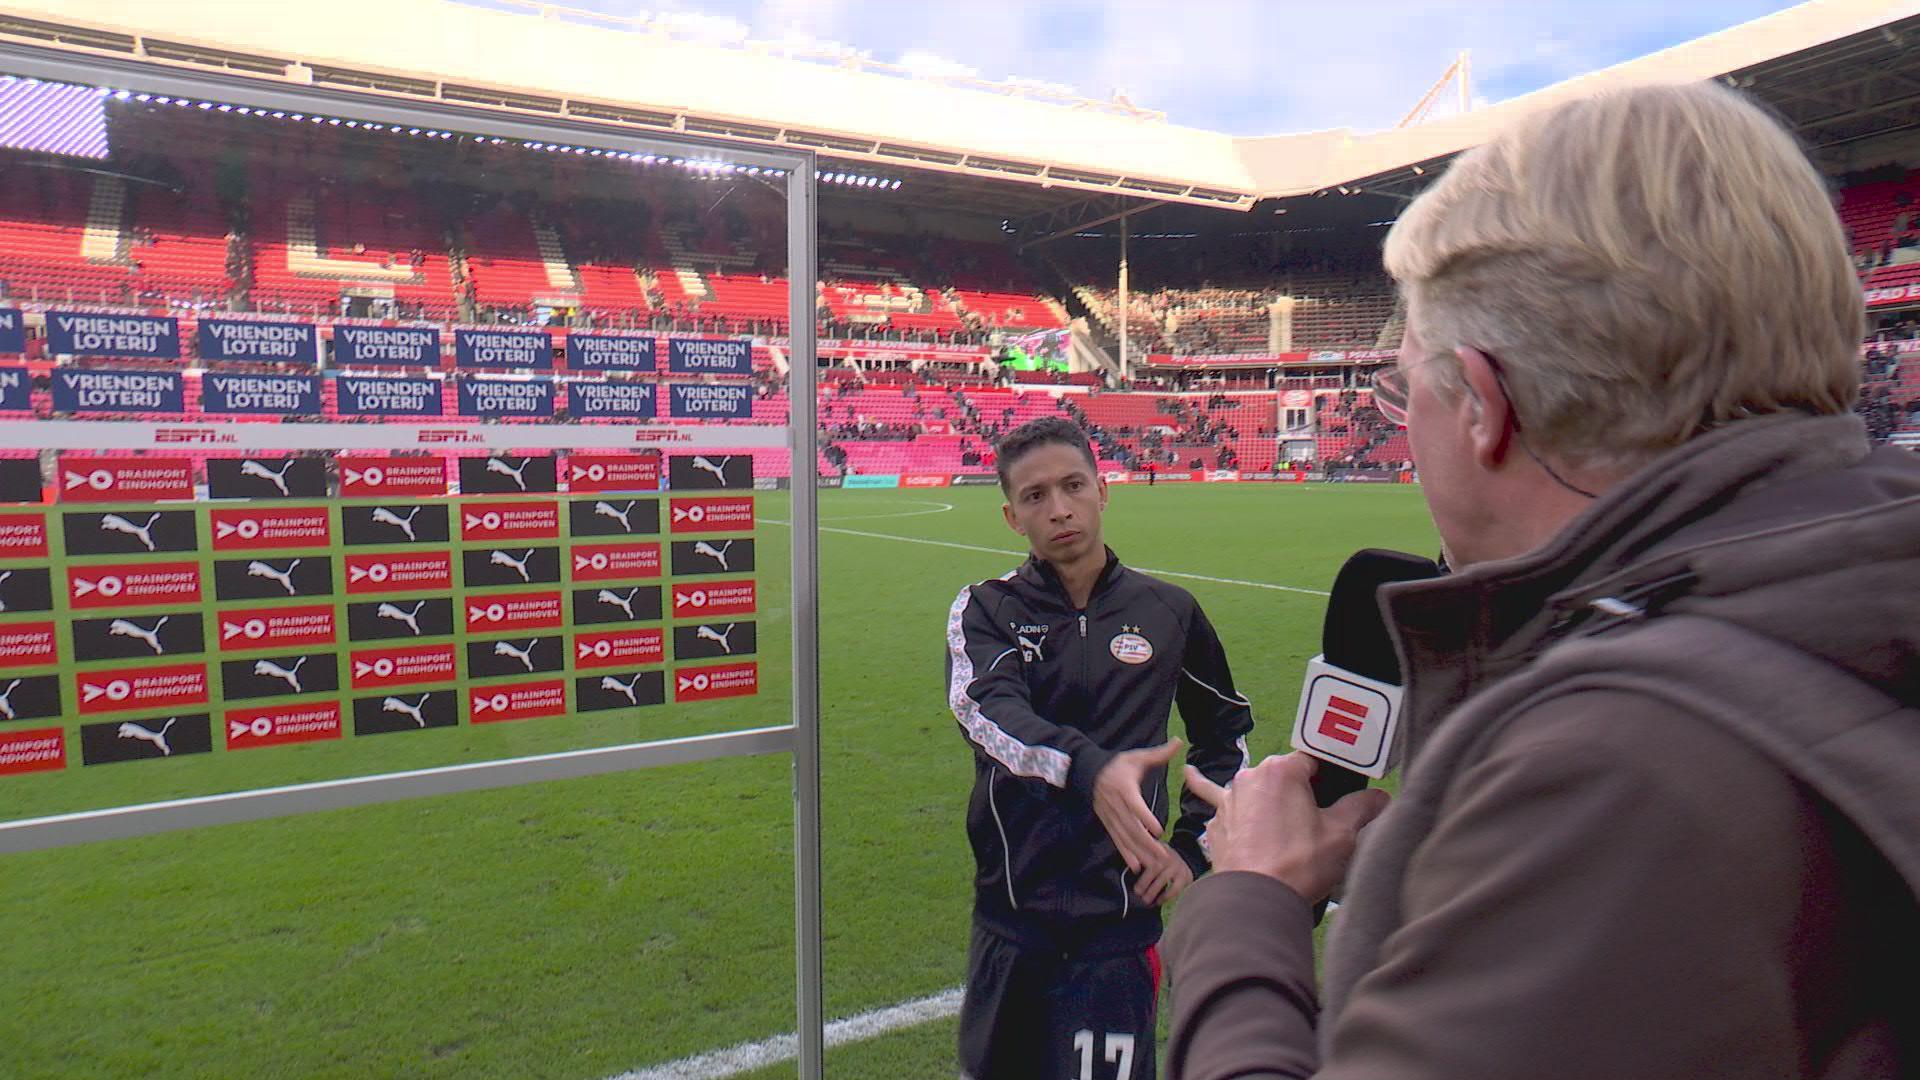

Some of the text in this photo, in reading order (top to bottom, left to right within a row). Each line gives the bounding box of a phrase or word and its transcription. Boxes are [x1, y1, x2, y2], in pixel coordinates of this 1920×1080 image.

[58, 317, 170, 336] VRIENDEN
[209, 323, 308, 342] VRIENDEN
[73, 334, 156, 352] LOTERIJ
[343, 330, 432, 346] VRIENDEN
[464, 333, 545, 349] VRIENDEN
[573, 336, 648, 351] VRIENDEN
[222, 339, 296, 357] LOTERIJ
[355, 344, 422, 360] LOTERIJ
[676, 341, 745, 356] VRIENDEN
[474, 348, 535, 362] LOTERIJ
[584, 350, 640, 366] LOTERIJ
[685, 354, 736, 369] LOTERIJ
[62, 374, 174, 391] VRIENDEN
[213, 378, 311, 394] VRIENDEN
[346, 380, 434, 395] VRIENDEN
[466, 383, 547, 397] VRIENDEN
[575, 385, 650, 399] VRIENDEN
[677, 386, 746, 401] VRIENDEN
[78, 389, 161, 407] LOTERIJ
[226, 392, 299, 409] LOTERIJ
[357, 394, 424, 410] LOTERIJ
[477, 397, 537, 411] LOTERIJ
[585, 398, 641, 412] LOTERIJ
[686, 400, 737, 413] LOTERIJ
[386, 467, 442, 478] BRAINPORT
[607, 463, 655, 473] BRAINPORT
[117, 469, 186, 481] BRAINPORT
[387, 476, 443, 486] EINDHOVEN
[608, 472, 656, 482] EINDHOVEN
[118, 478, 188, 490] EINDHOVEN
[503, 510, 554, 521] BRAINPORT
[706, 504, 750, 514] BRAINPORT
[707, 511, 751, 521] EINDHOVEN
[262, 517, 324, 529] BRAINPORT
[504, 519, 555, 529] EINDHOVEN
[263, 527, 325, 538] EINDHOVEN
[610, 551, 657, 561] BRAINPORT
[391, 561, 447, 573] BRAINPORT
[610, 558, 658, 568] EINDHOVEN
[127, 572, 195, 586] BRAINPORT
[392, 570, 448, 582] EINDHOVEN
[127, 582, 196, 595] EINDHOVEN
[708, 588, 752, 598] BRAINPORT
[507, 600, 558, 612] BRAINPORT
[709, 595, 753, 605] EINDHOVEN
[508, 608, 559, 620] EINDHOVEN
[269, 615, 330, 628] BRAINPORT
[270, 624, 330, 637] EINDHOVEN
[613, 636, 660, 647] BRAINPORT
[614, 644, 660, 656] EINDHOVEN
[396, 653, 451, 667] BRAINPORT
[397, 662, 452, 675] EINDHOVEN
[712, 669, 754, 681] BRAINPORT
[134, 674, 202, 689] BRAINPORT
[712, 677, 755, 689] EINDHOVEN
[135, 684, 203, 698] EINDHOVEN
[511, 689, 561, 701] BRAINPORT
[512, 697, 562, 710] EINDHOVEN
[276, 711, 336, 726] BRAINPORT
[1318, 695, 1368, 746] E
[276, 720, 336, 735] EINDHOVEN
[1073, 1028, 1134, 1080] 17
